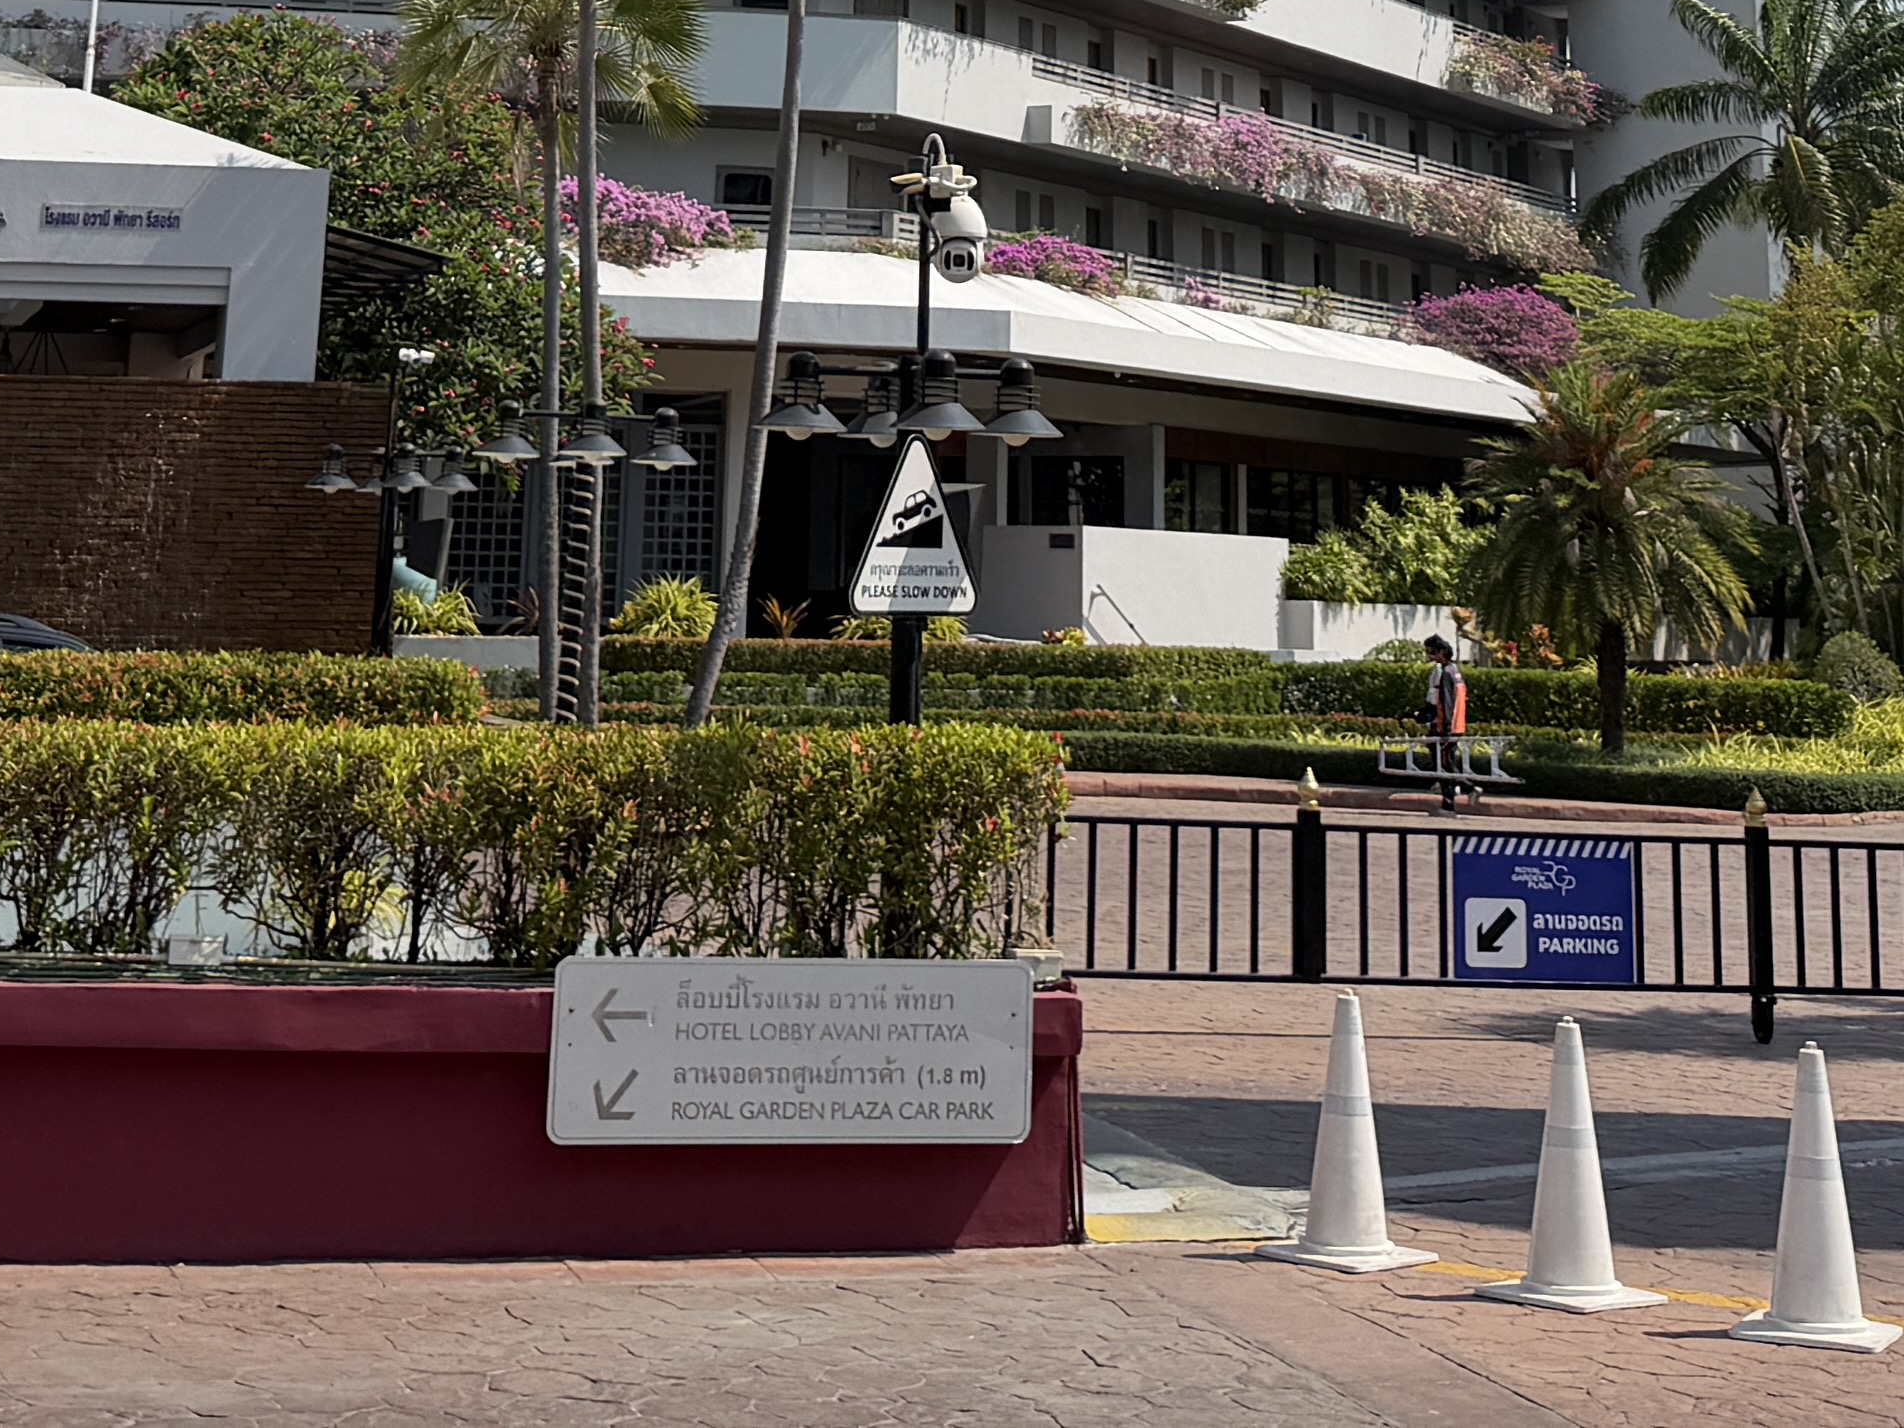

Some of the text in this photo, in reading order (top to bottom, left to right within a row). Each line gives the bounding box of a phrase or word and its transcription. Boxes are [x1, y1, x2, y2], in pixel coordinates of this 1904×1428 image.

[861, 585, 967, 598] PLEASE SLOW DOWN
[1533, 913, 1623, 931] ลานจอดรถ
[1538, 937, 1619, 955] PARKING
[675, 1022, 969, 1042] HOTEL LOBBY AVANI PATTAYA
[917, 1064, 954, 1090] (1.8
[959, 1064, 986, 1090] m)
[671, 1101, 995, 1121] ROYAL GARDEN PLAZA CAR PARK
